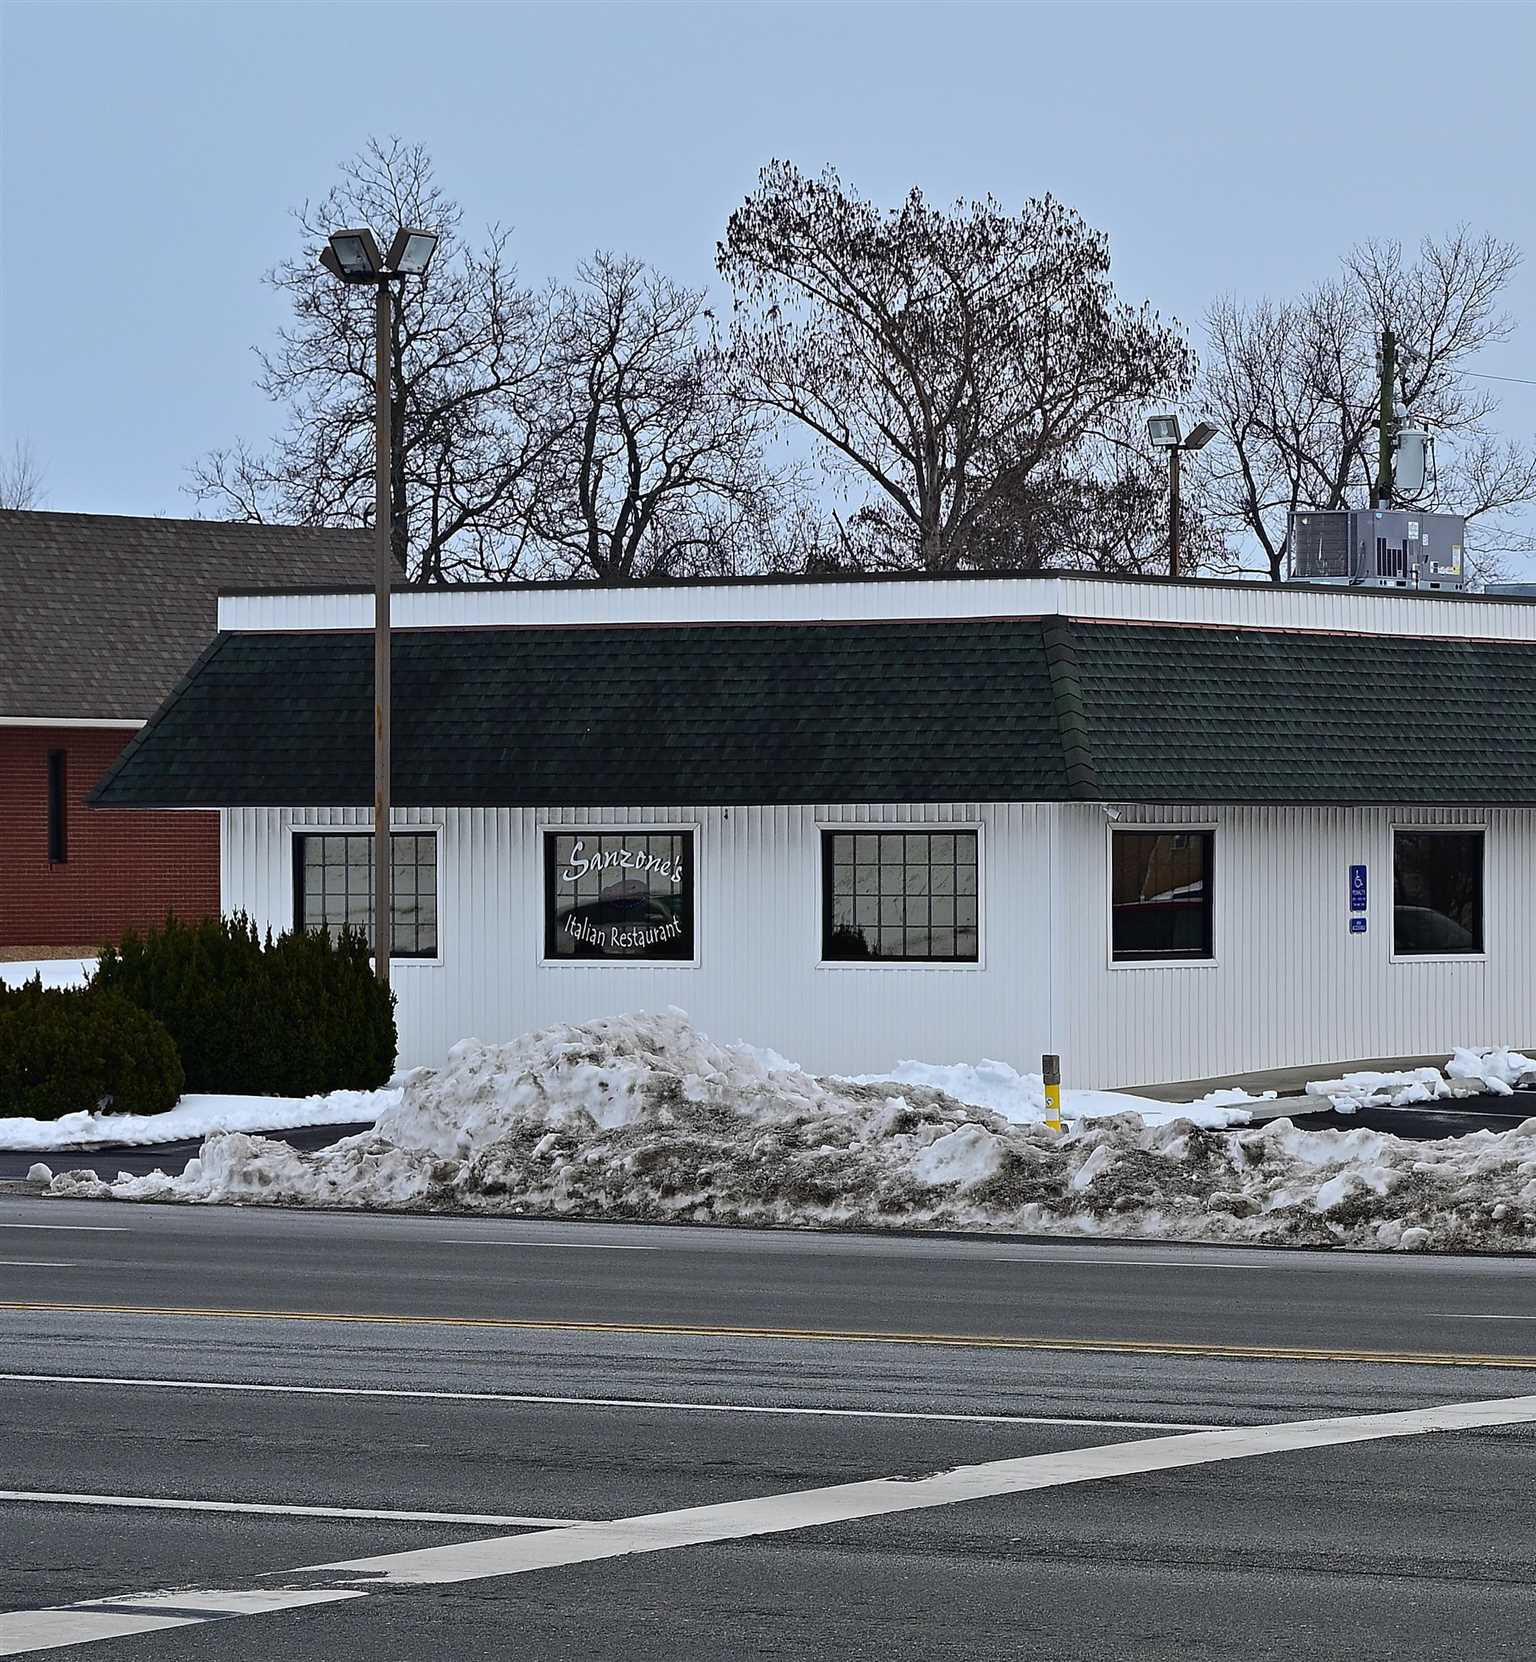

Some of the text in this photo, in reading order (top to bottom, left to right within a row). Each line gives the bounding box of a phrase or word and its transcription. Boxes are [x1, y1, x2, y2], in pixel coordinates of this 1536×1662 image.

[563, 841, 683, 883] Sanzone's
[564, 914, 682, 949] Italian Restaurant
